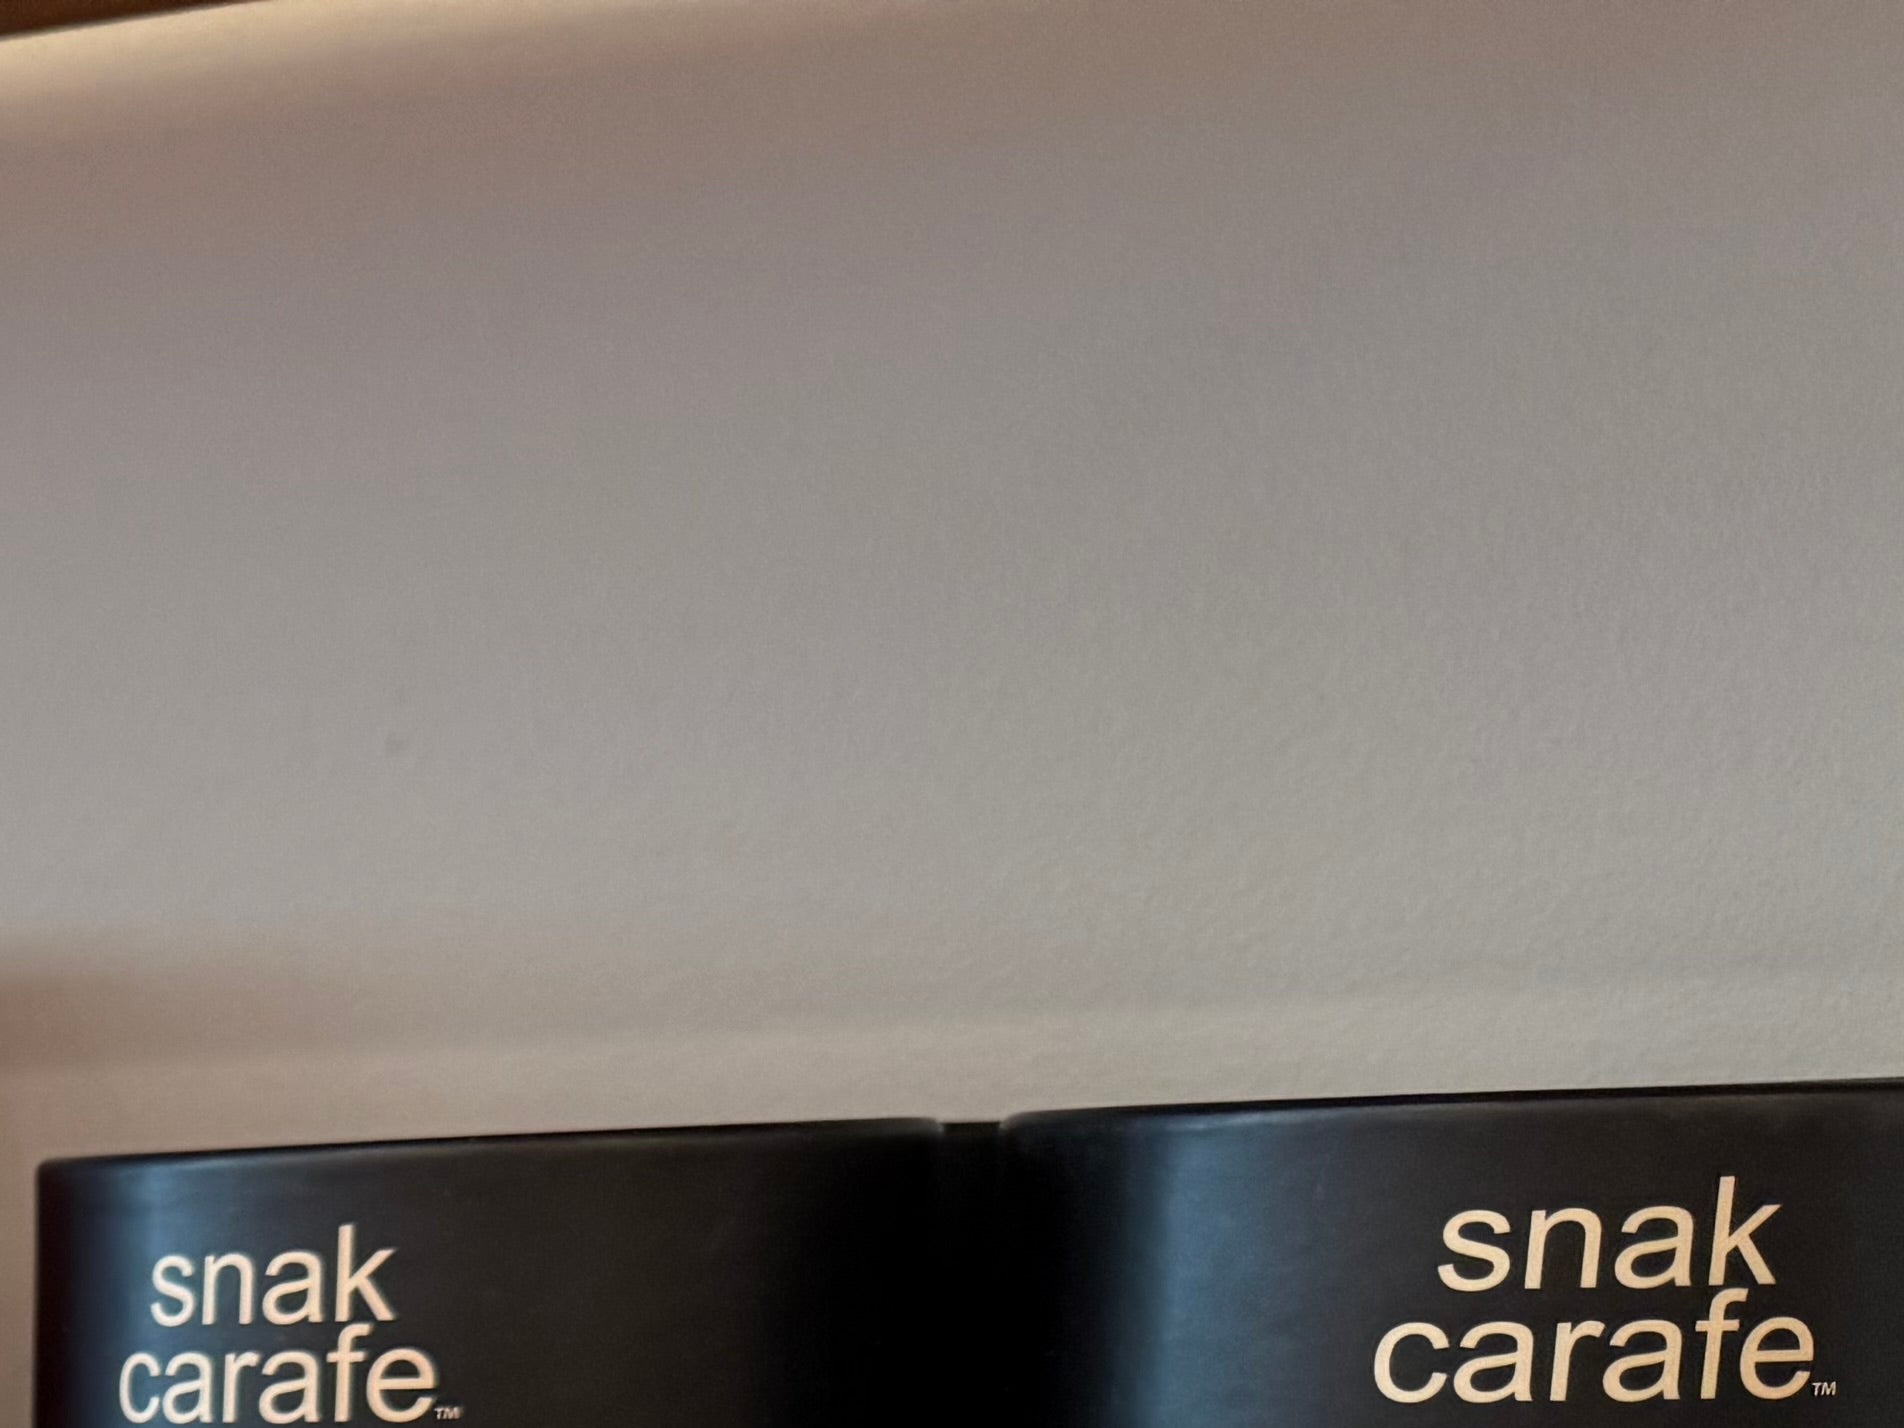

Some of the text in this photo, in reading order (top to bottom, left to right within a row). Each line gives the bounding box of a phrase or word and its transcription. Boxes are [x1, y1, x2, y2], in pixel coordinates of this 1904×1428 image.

[149, 1223, 398, 1328] snak
[1436, 1174, 1784, 1293] snak
[119, 1322, 439, 1426] carafe
[1372, 1287, 1816, 1404] carafe
